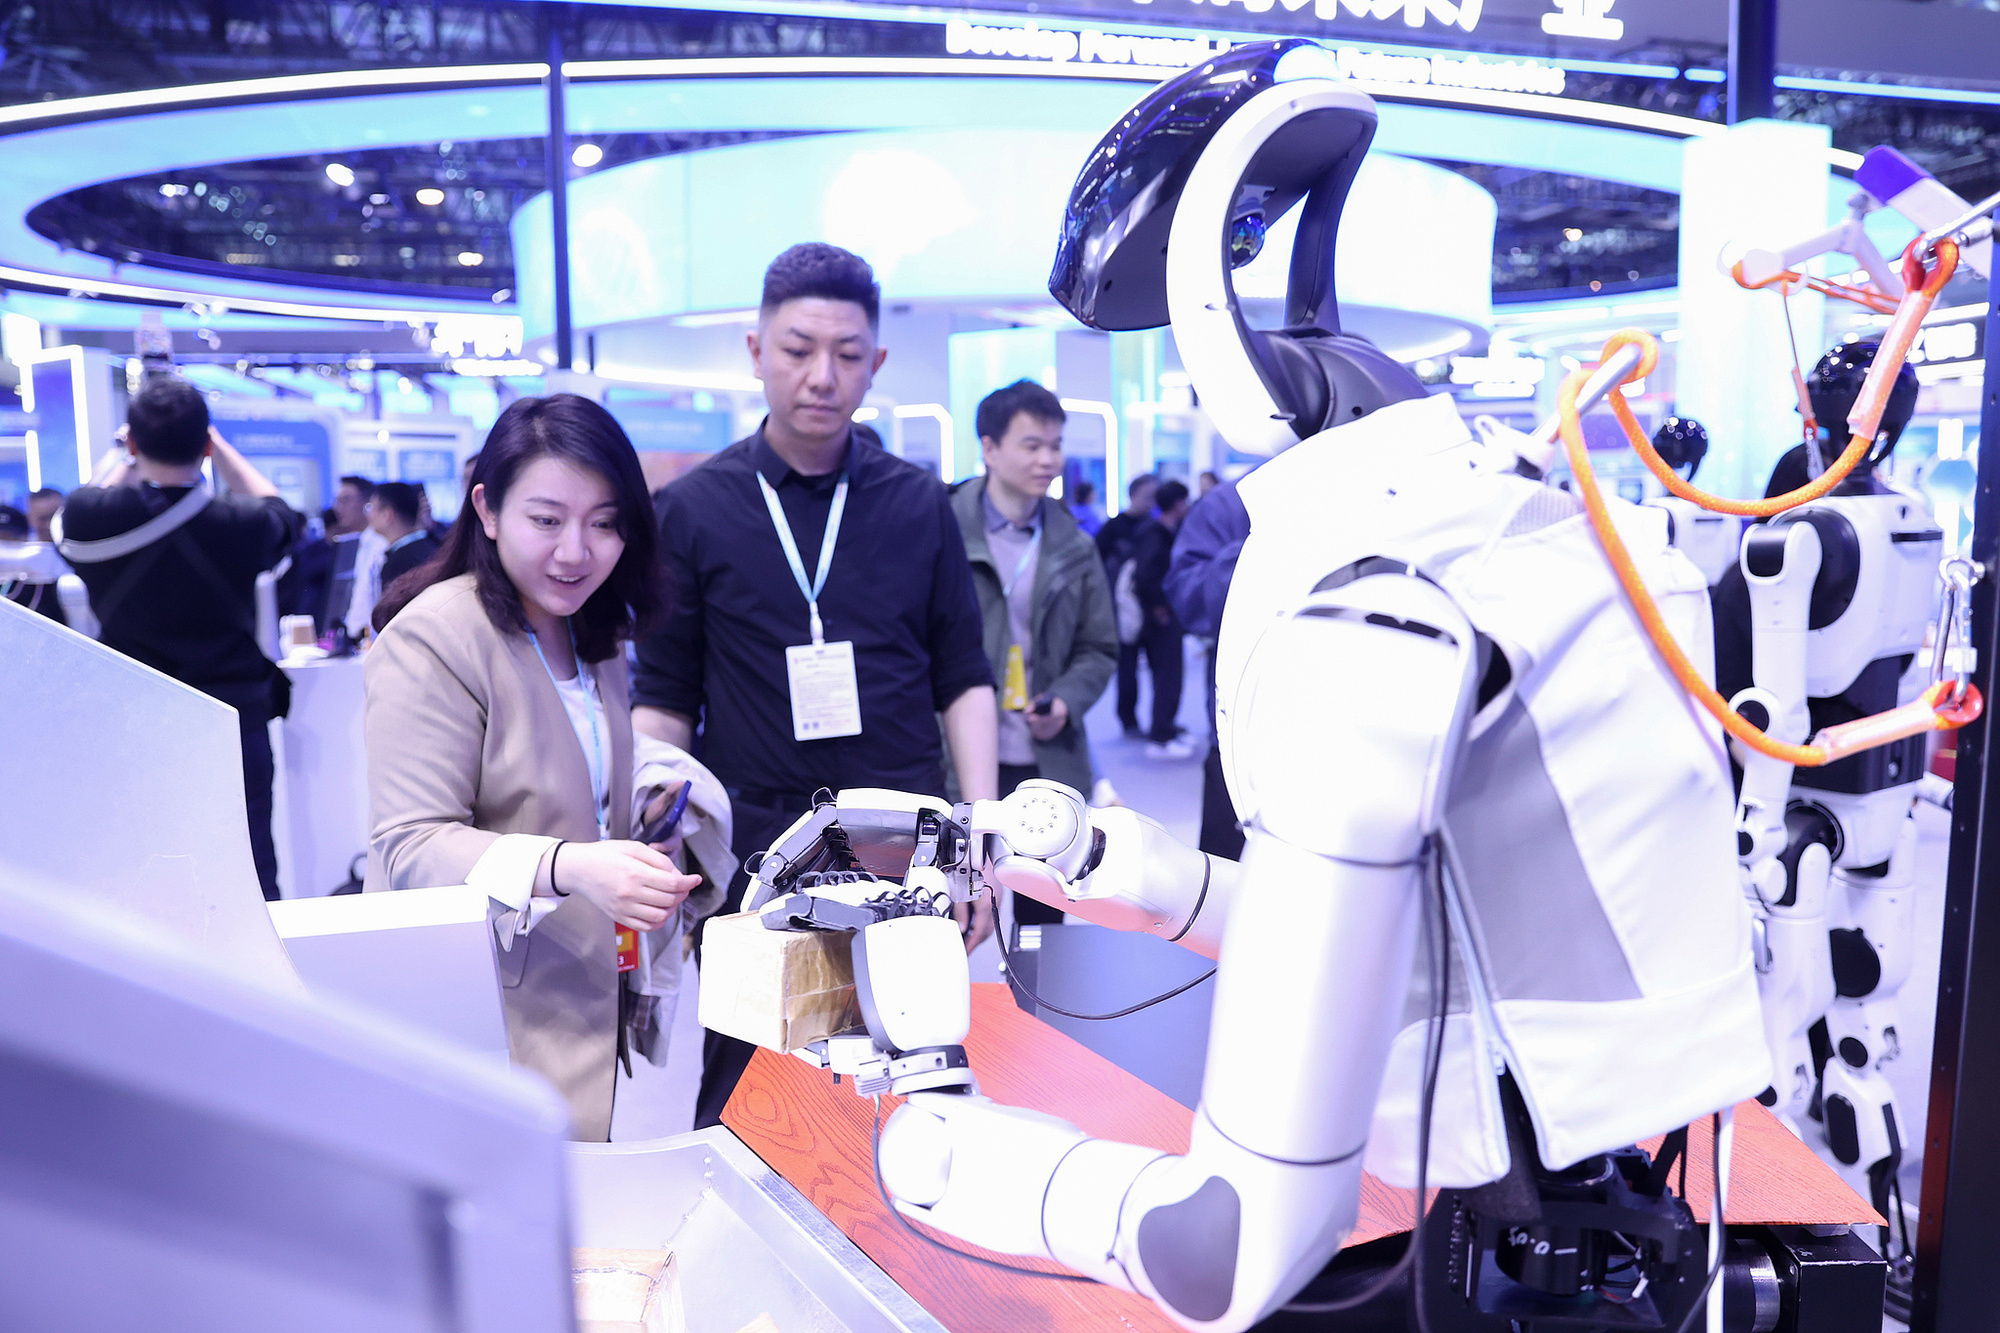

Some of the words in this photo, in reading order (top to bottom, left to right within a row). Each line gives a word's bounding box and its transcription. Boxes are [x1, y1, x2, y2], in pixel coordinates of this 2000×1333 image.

[946, 19, 1078, 62] Develop
[1336, 47, 1431, 84] Future
[1431, 53, 1566, 95] Industries
